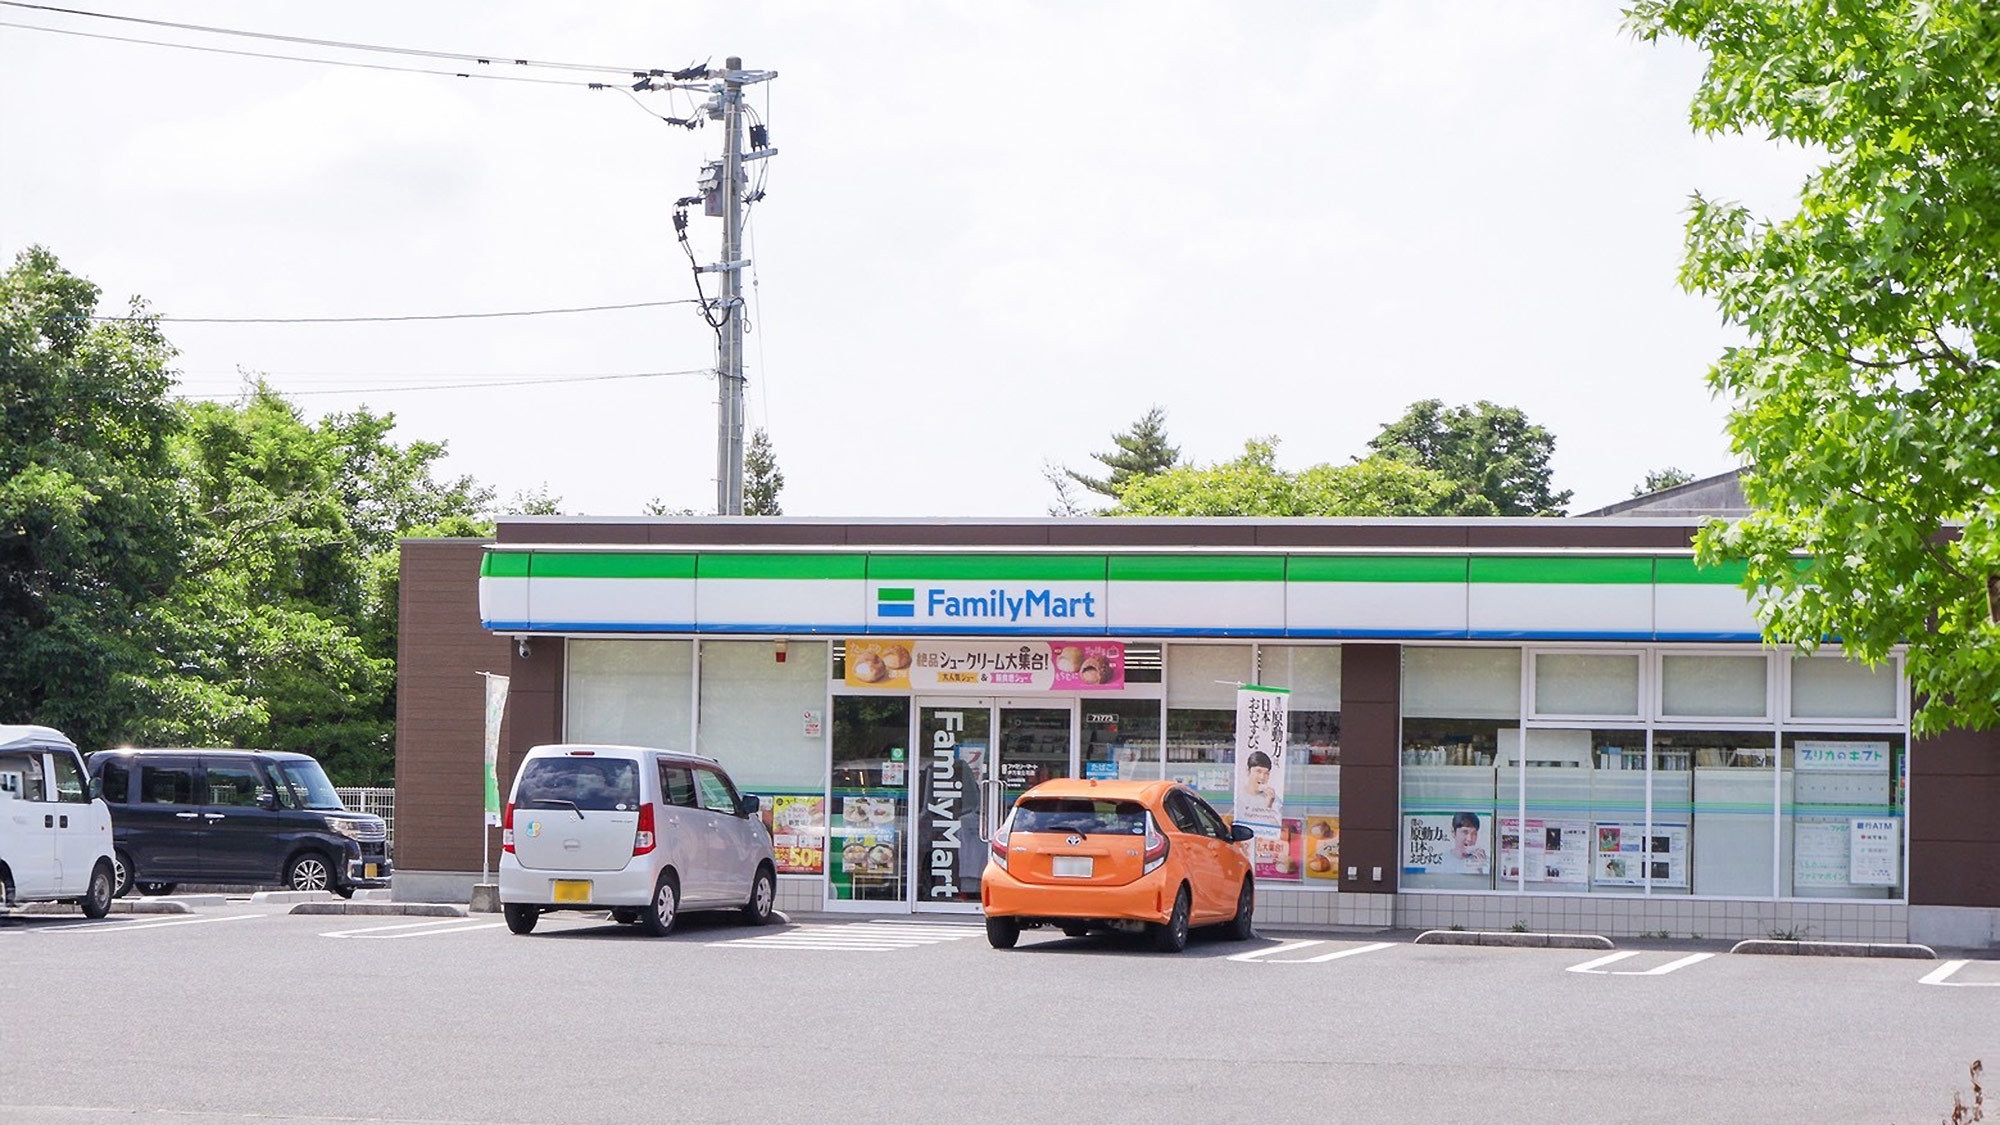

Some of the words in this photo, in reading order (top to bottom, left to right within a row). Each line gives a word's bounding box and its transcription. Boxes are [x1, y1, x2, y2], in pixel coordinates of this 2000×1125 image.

[927, 589, 1095, 622] FamilyMart
[981, 673, 989, 682] &
[1091, 762, 1113, 772] たばこ
[928, 711, 964, 898] FamilyMart
